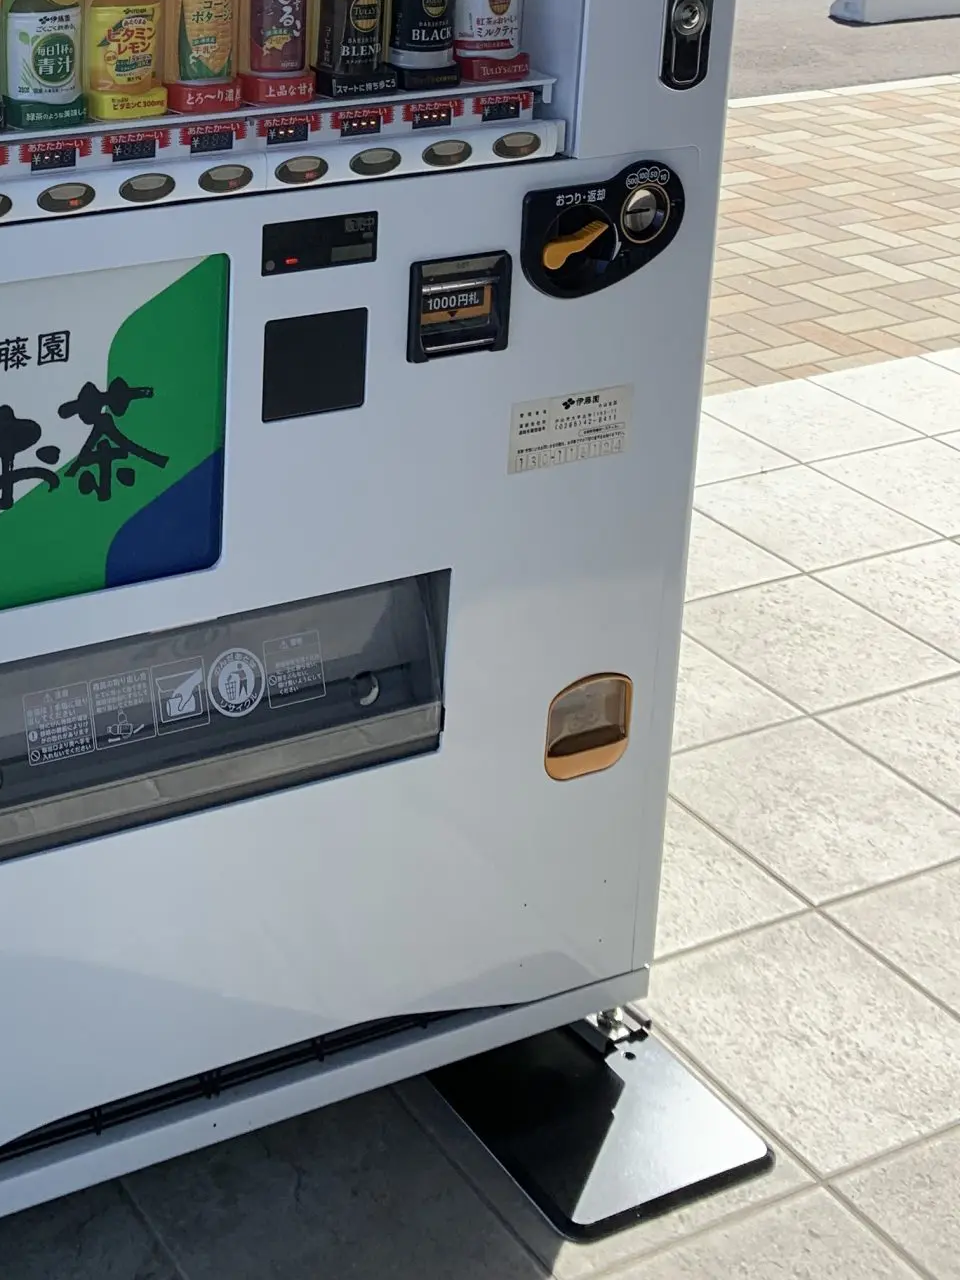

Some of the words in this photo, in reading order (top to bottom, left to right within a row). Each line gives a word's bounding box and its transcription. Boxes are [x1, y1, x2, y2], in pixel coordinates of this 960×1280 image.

[106, 26, 156, 44] ビタミン
[411, 25, 452, 42] BLACK
[476, 25, 518, 39] ミルクティー
[117, 41, 151, 57] レモン
[341, 41, 381, 57] BLEND
[37, 54, 73, 75] 青汁
[265, 84, 314, 99] 上品な甘み
[336, 79, 397, 95] スマートに持ち歩こう
[555, 188, 606, 208] おつり・返却
[427, 292, 479, 312] 1000円札
[220, 692, 257, 712] リサイクル
